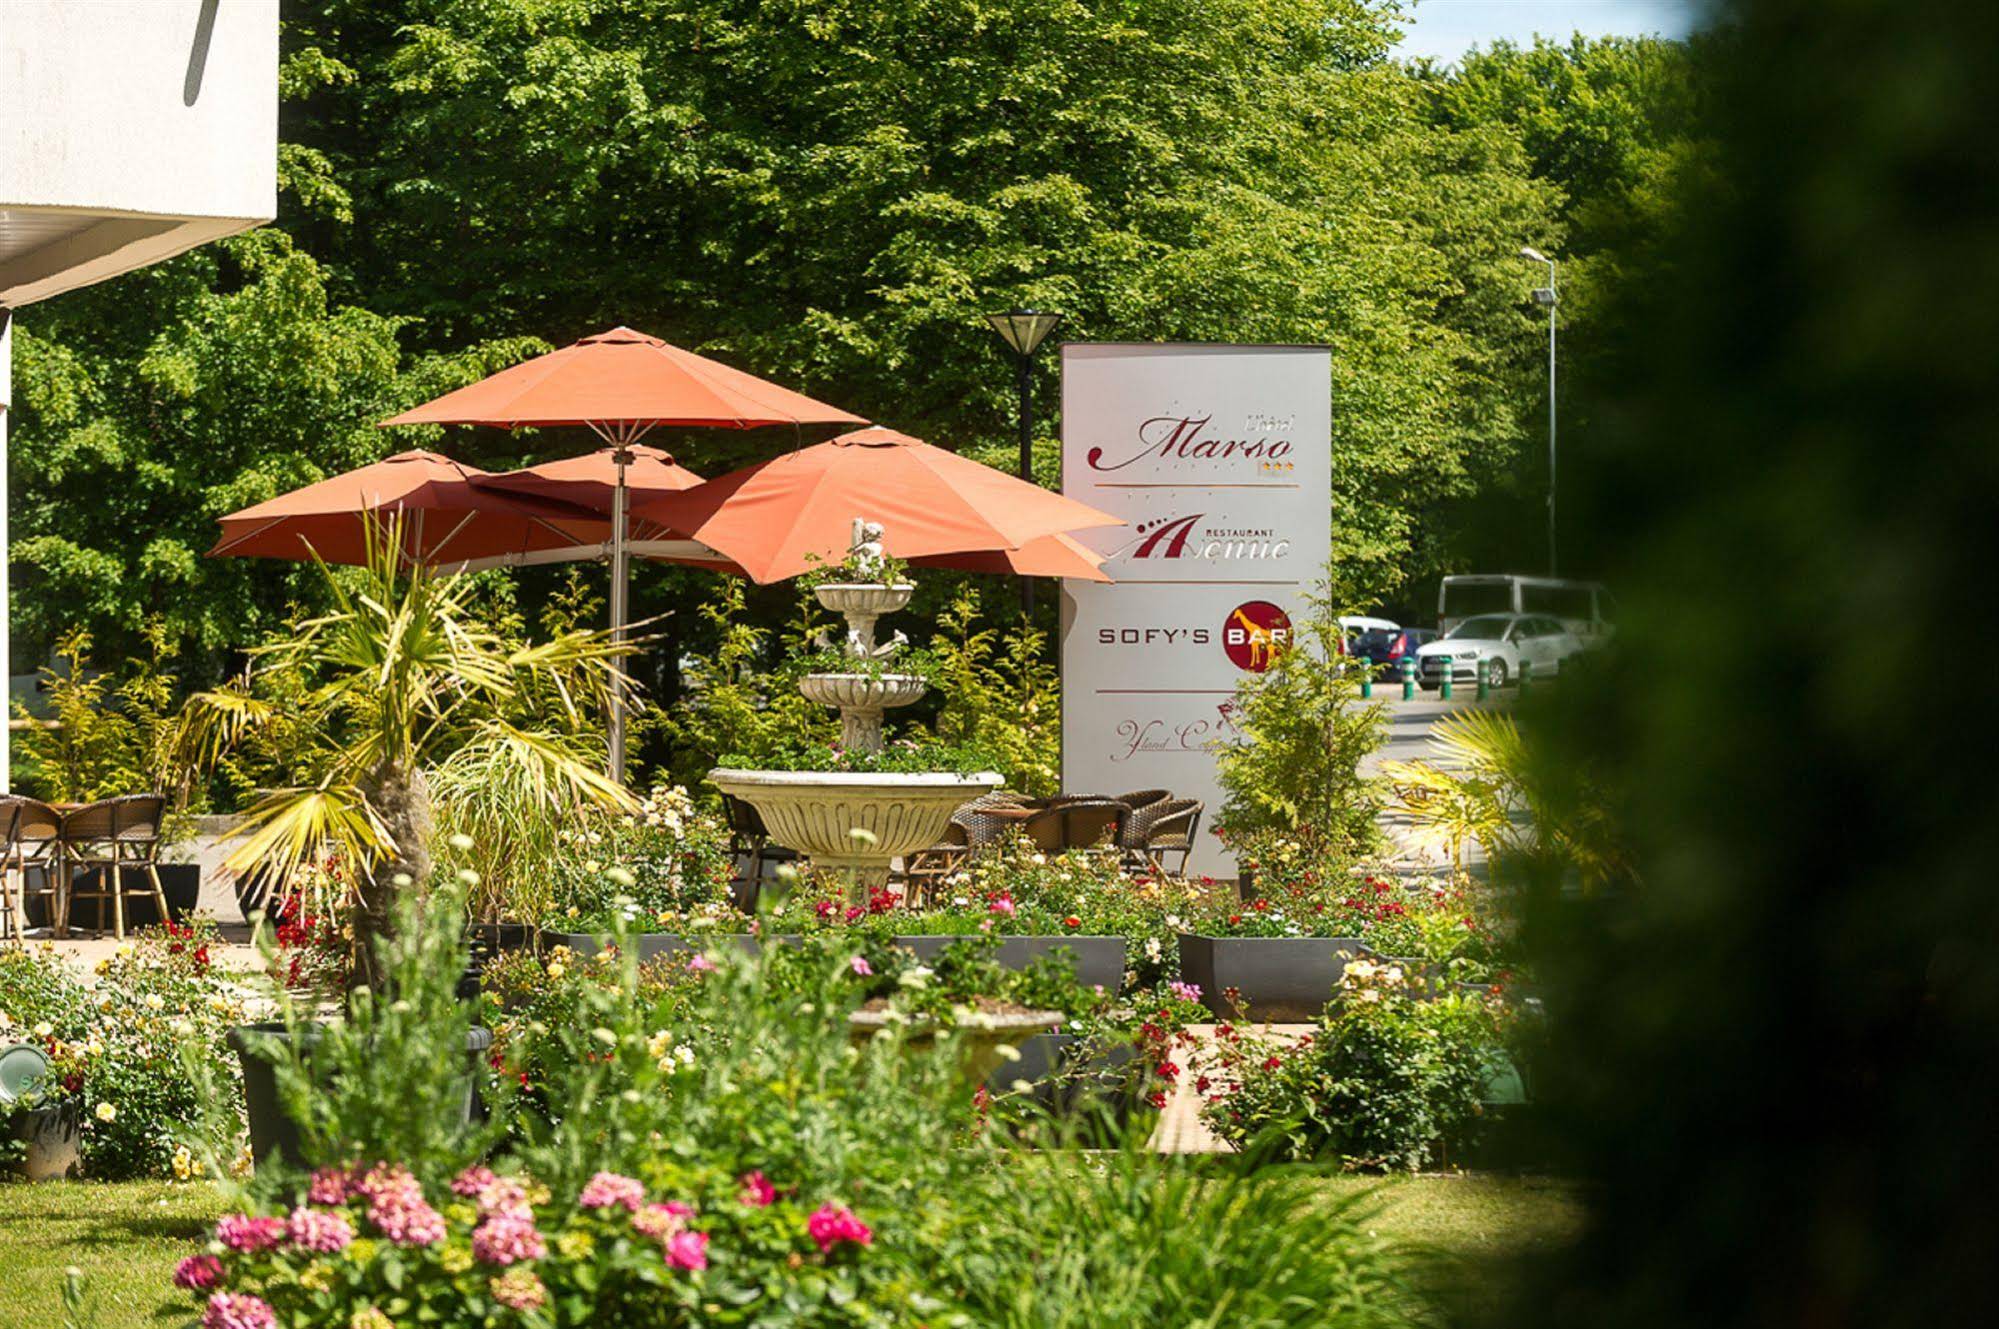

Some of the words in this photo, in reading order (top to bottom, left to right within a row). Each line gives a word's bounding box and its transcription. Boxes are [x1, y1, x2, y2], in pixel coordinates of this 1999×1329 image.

[1088, 414, 1294, 471] Marso
[1206, 529, 1274, 537] RESTAURANT
[1099, 629, 1209, 643] SOFY'S
[1227, 628, 1288, 644] BAR
